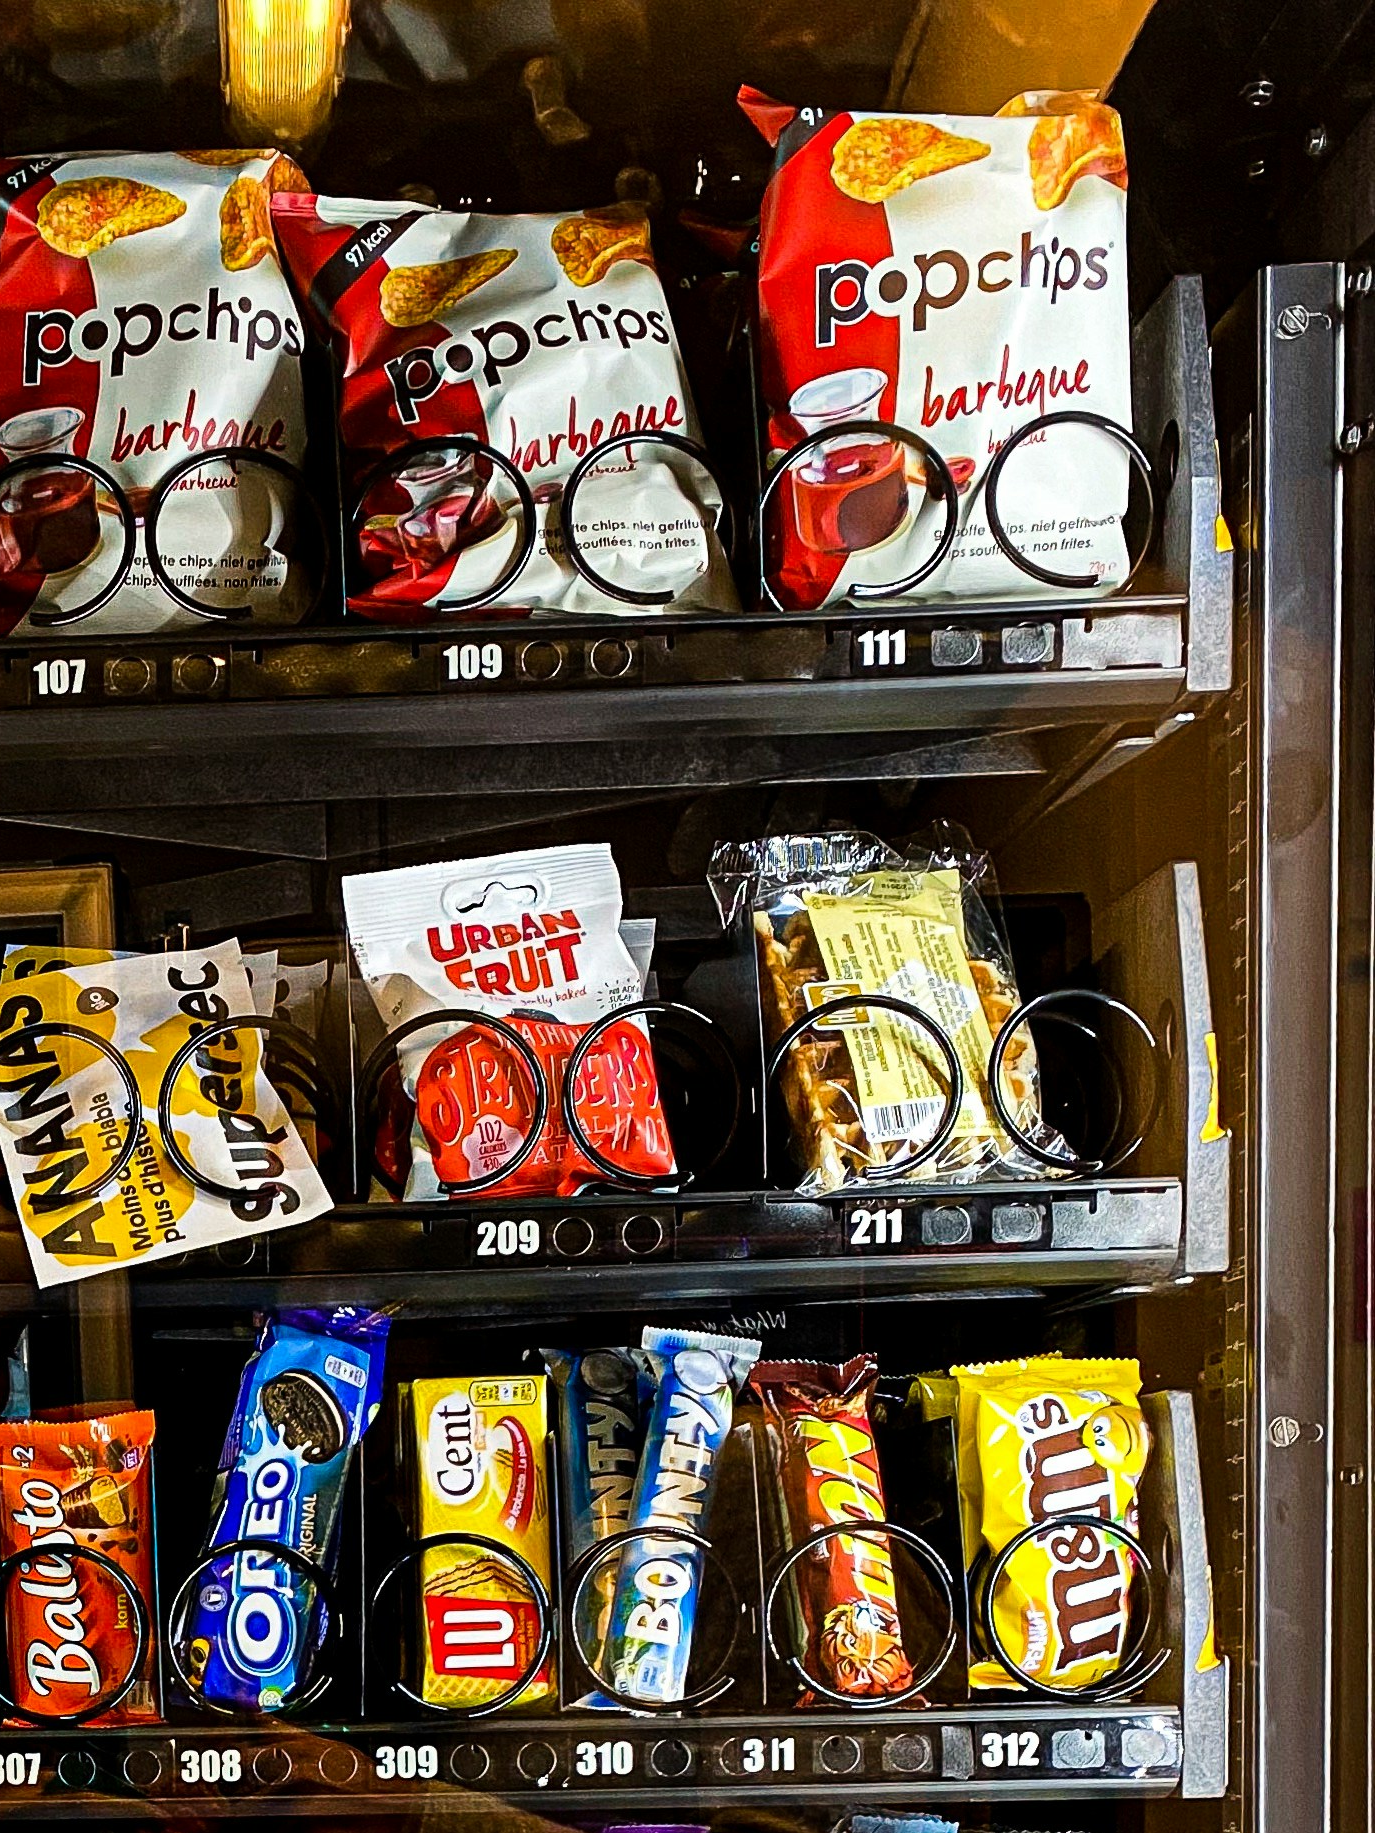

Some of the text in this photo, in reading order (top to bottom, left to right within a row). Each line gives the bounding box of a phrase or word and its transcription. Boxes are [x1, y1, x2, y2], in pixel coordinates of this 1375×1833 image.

[7, 168, 28, 189] 97
[345, 222, 393, 269] 97 kcal
[816, 230, 1109, 348] popchips
[23, 287, 304, 386] popchips
[385, 300, 671, 425] popchips
[920, 343, 1090, 427] barbeque
[591, 514, 656, 535] chips. niet
[1031, 515, 1062, 538] niet
[179, 551, 247, 574] chips. niet
[638, 534, 700, 554] non frites.
[1033, 536, 1095, 559] non frites.
[443, 643, 503, 680] 109
[858, 628, 906, 665] 111
[33, 659, 86, 695] 107
[426, 909, 583, 963] URBAN
[476, 1121, 503, 1147] 102
[152, 1180, 187, 1244] plus
[850, 1208, 903, 1243] 211
[476, 1219, 540, 1260] 209
[436, 1403, 476, 1497] Cent
[622, 1393, 723, 1647] BOUNTY
[235, 1460, 295, 1663] OREO
[13, 1480, 101, 1696] Balisto
[443, 1609, 516, 1669] LU
[1023, 1609, 1050, 1673] PEANUT
[181, 1750, 242, 1783] 308
[376, 1746, 439, 1780] 309
[576, 1742, 635, 1776] 310
[742, 1738, 796, 1773] 311
[980, 1731, 1041, 1767] 312
